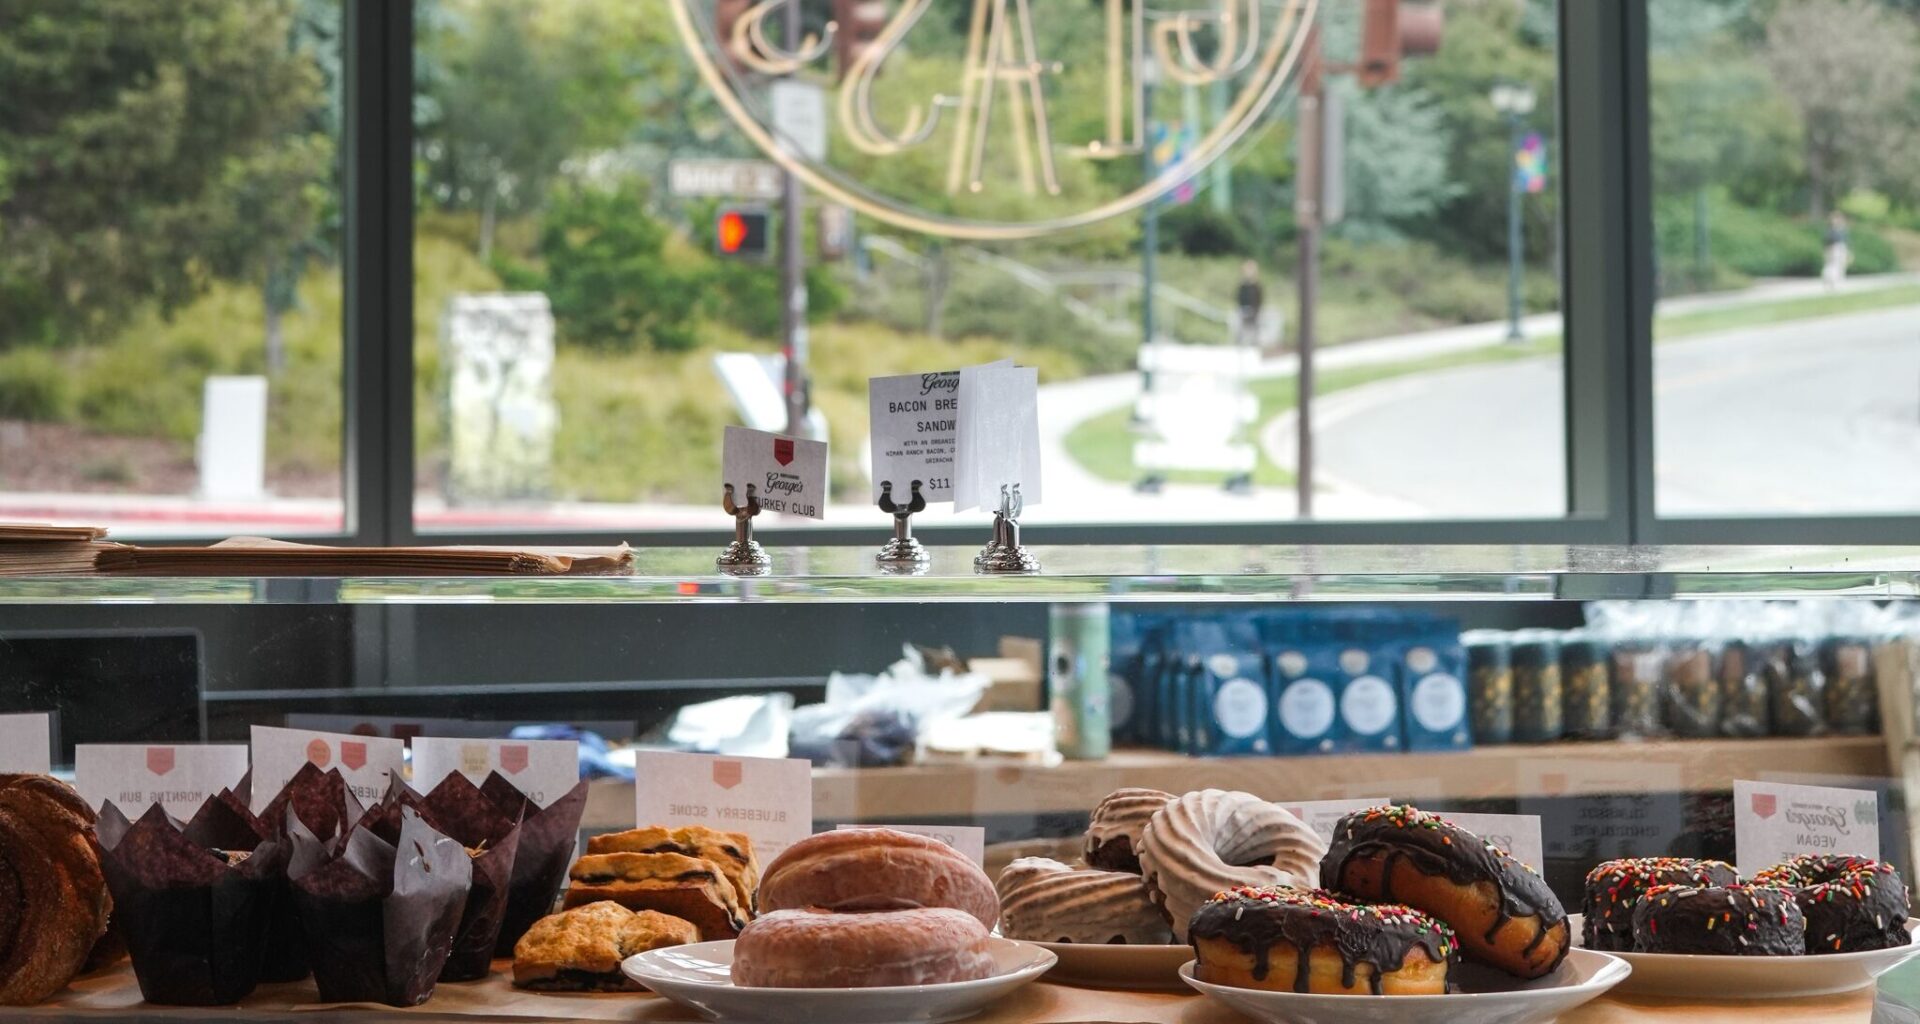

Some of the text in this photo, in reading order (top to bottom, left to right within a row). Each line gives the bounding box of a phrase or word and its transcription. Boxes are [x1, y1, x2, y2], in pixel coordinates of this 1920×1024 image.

[889, 399, 958, 413] BACON BRE
[917, 420, 956, 433] SANDW
[765, 472, 803, 496] George's
[929, 478, 950, 491] $11
[792, 503, 816, 517] CLUB
